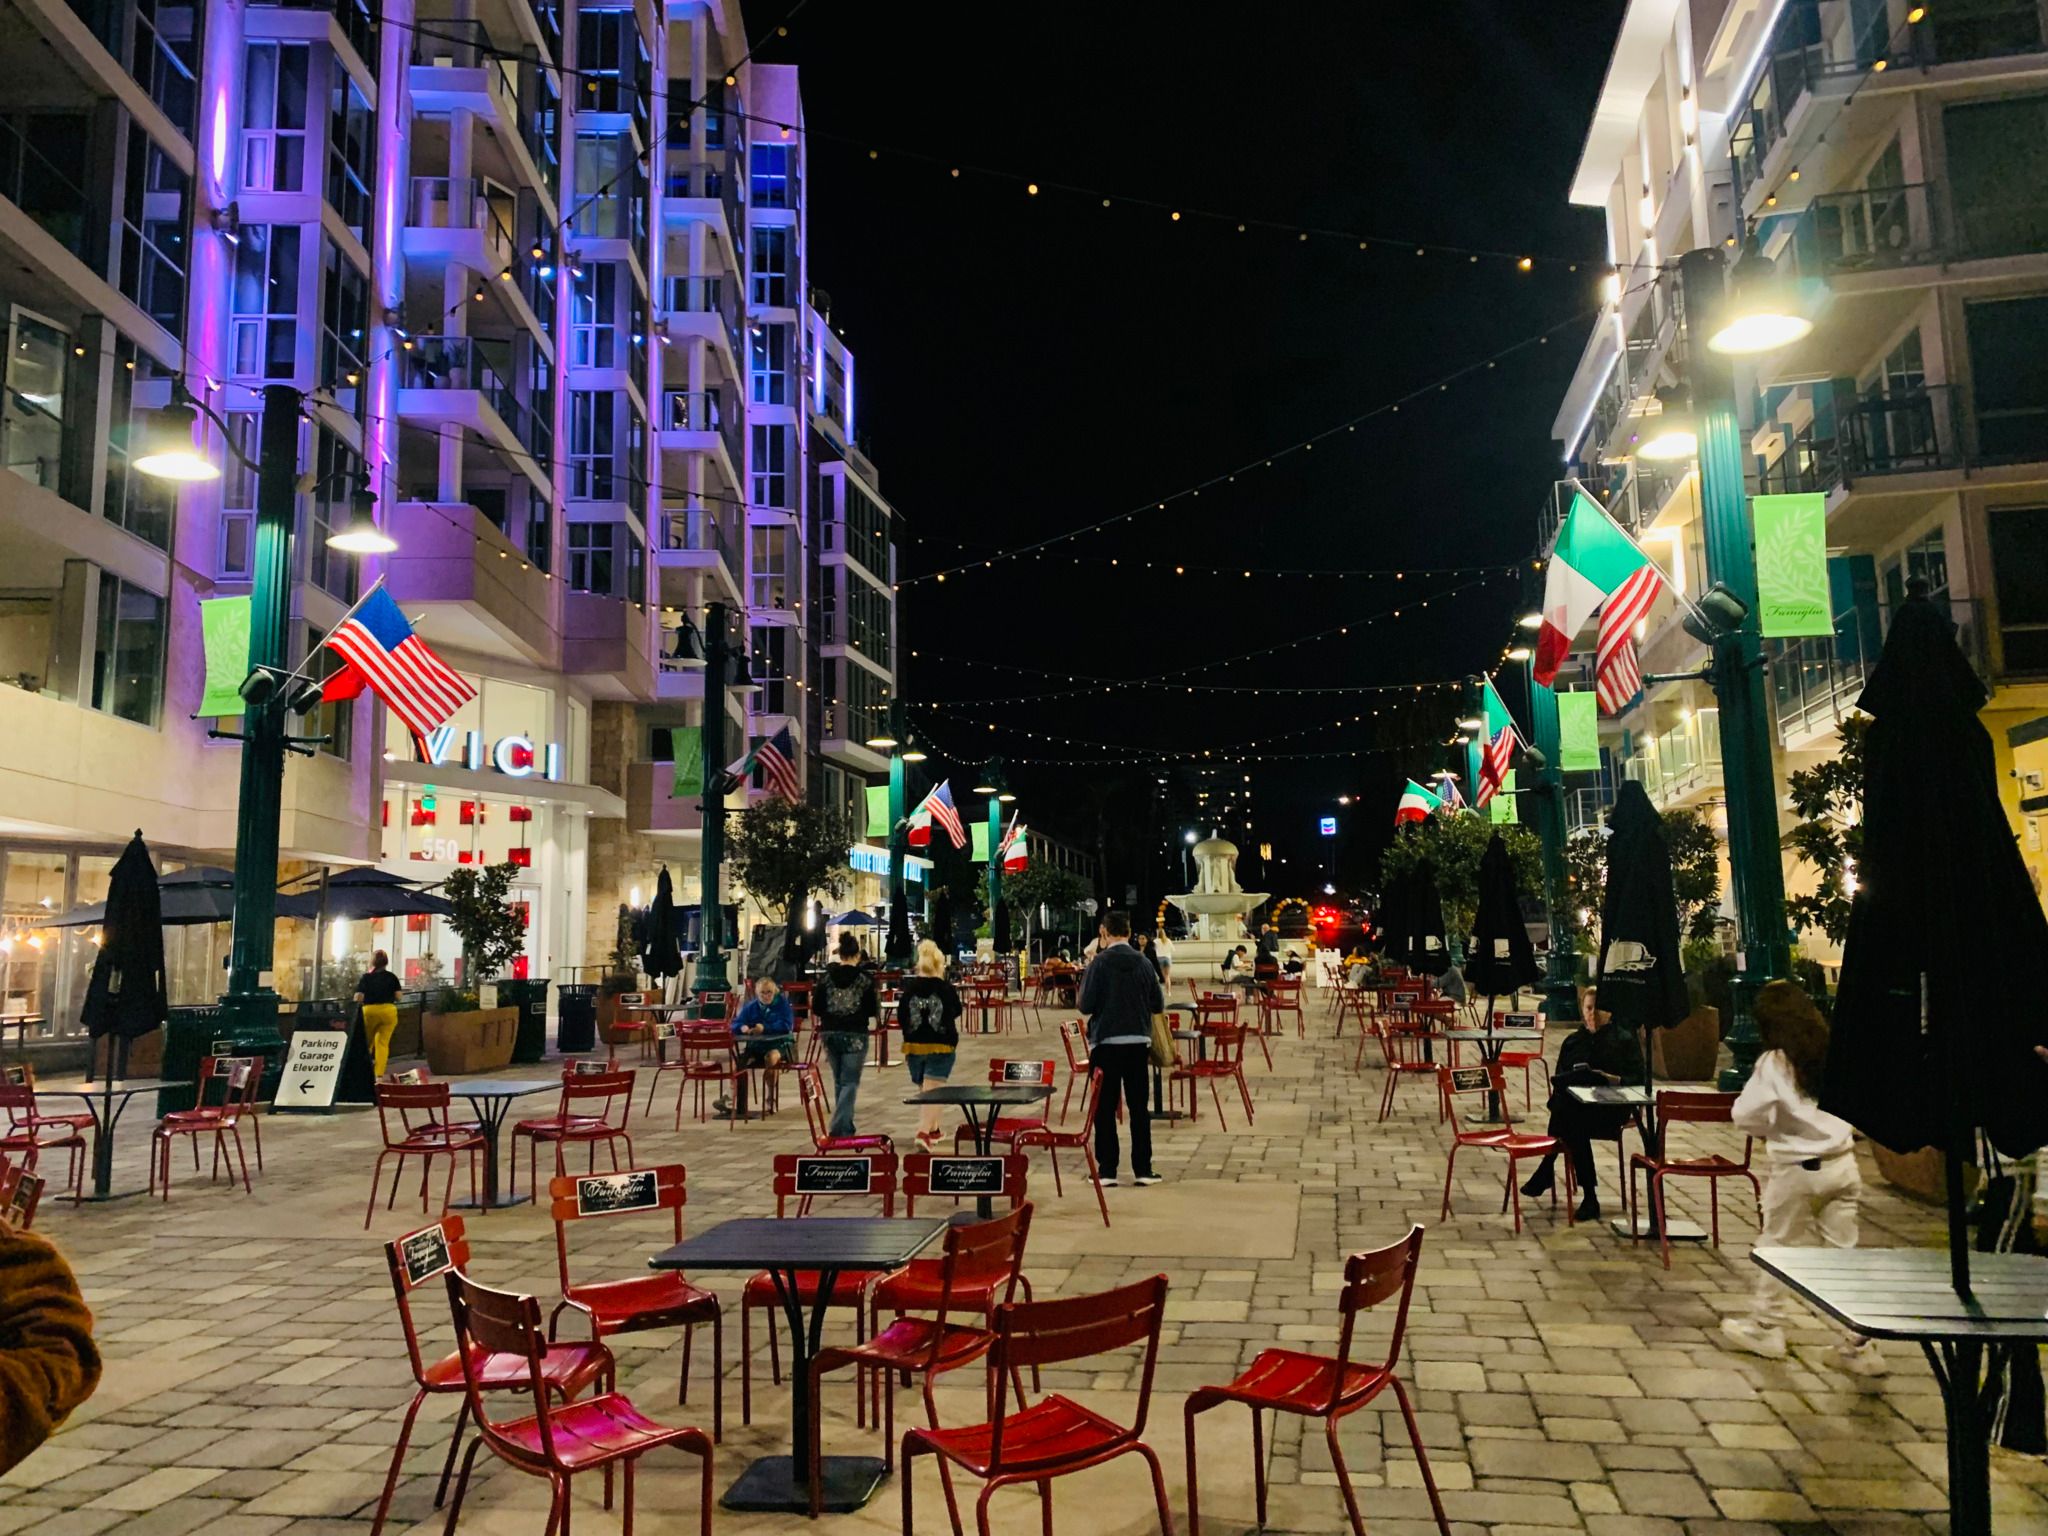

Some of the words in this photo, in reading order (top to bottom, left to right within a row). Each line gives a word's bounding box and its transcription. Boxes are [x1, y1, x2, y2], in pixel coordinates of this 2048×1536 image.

[421, 727, 558, 781] VICI
[421, 838, 459, 861] 550
[301, 1039, 339, 1050] Parking
[299, 1051, 335, 1062] Garage
[292, 1063, 335, 1072] Elevator
